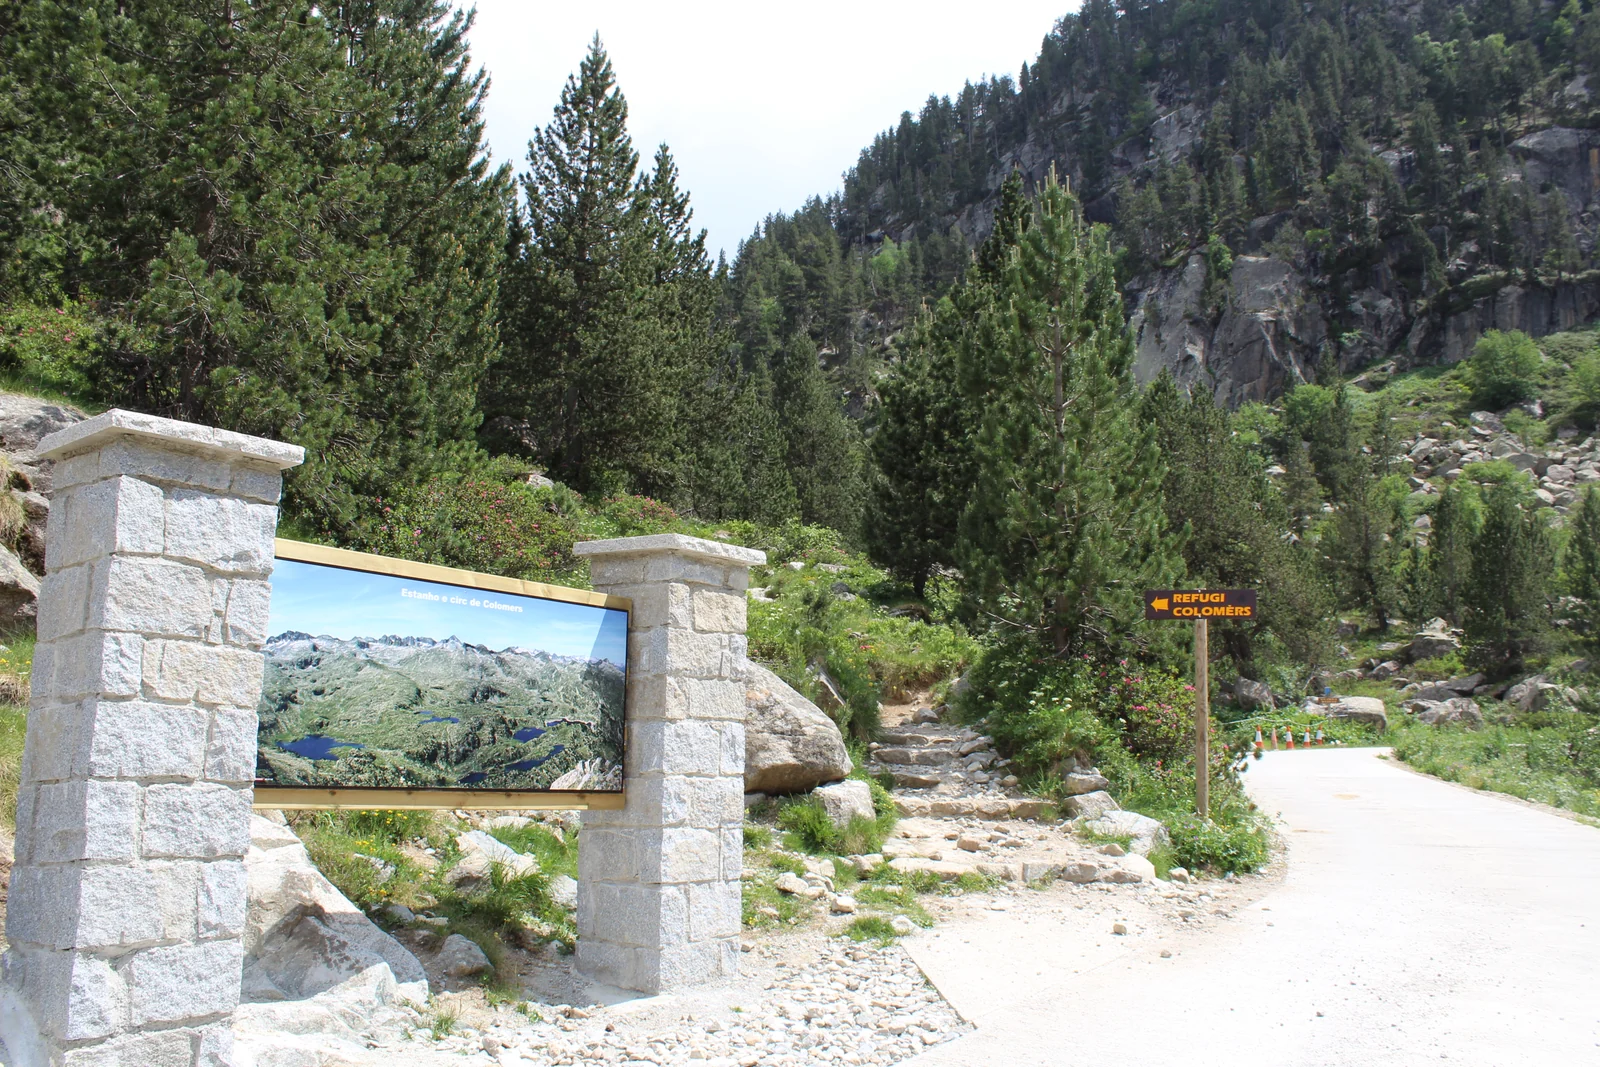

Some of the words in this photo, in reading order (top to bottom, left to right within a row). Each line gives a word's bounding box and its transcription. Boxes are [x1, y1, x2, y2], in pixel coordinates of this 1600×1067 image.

[401, 588, 439, 601] Estanho
[450, 595, 467, 605] circ
[470, 598, 480, 607] de
[483, 600, 523, 613] Colomers
[1173, 593, 1225, 602] REFUGI
